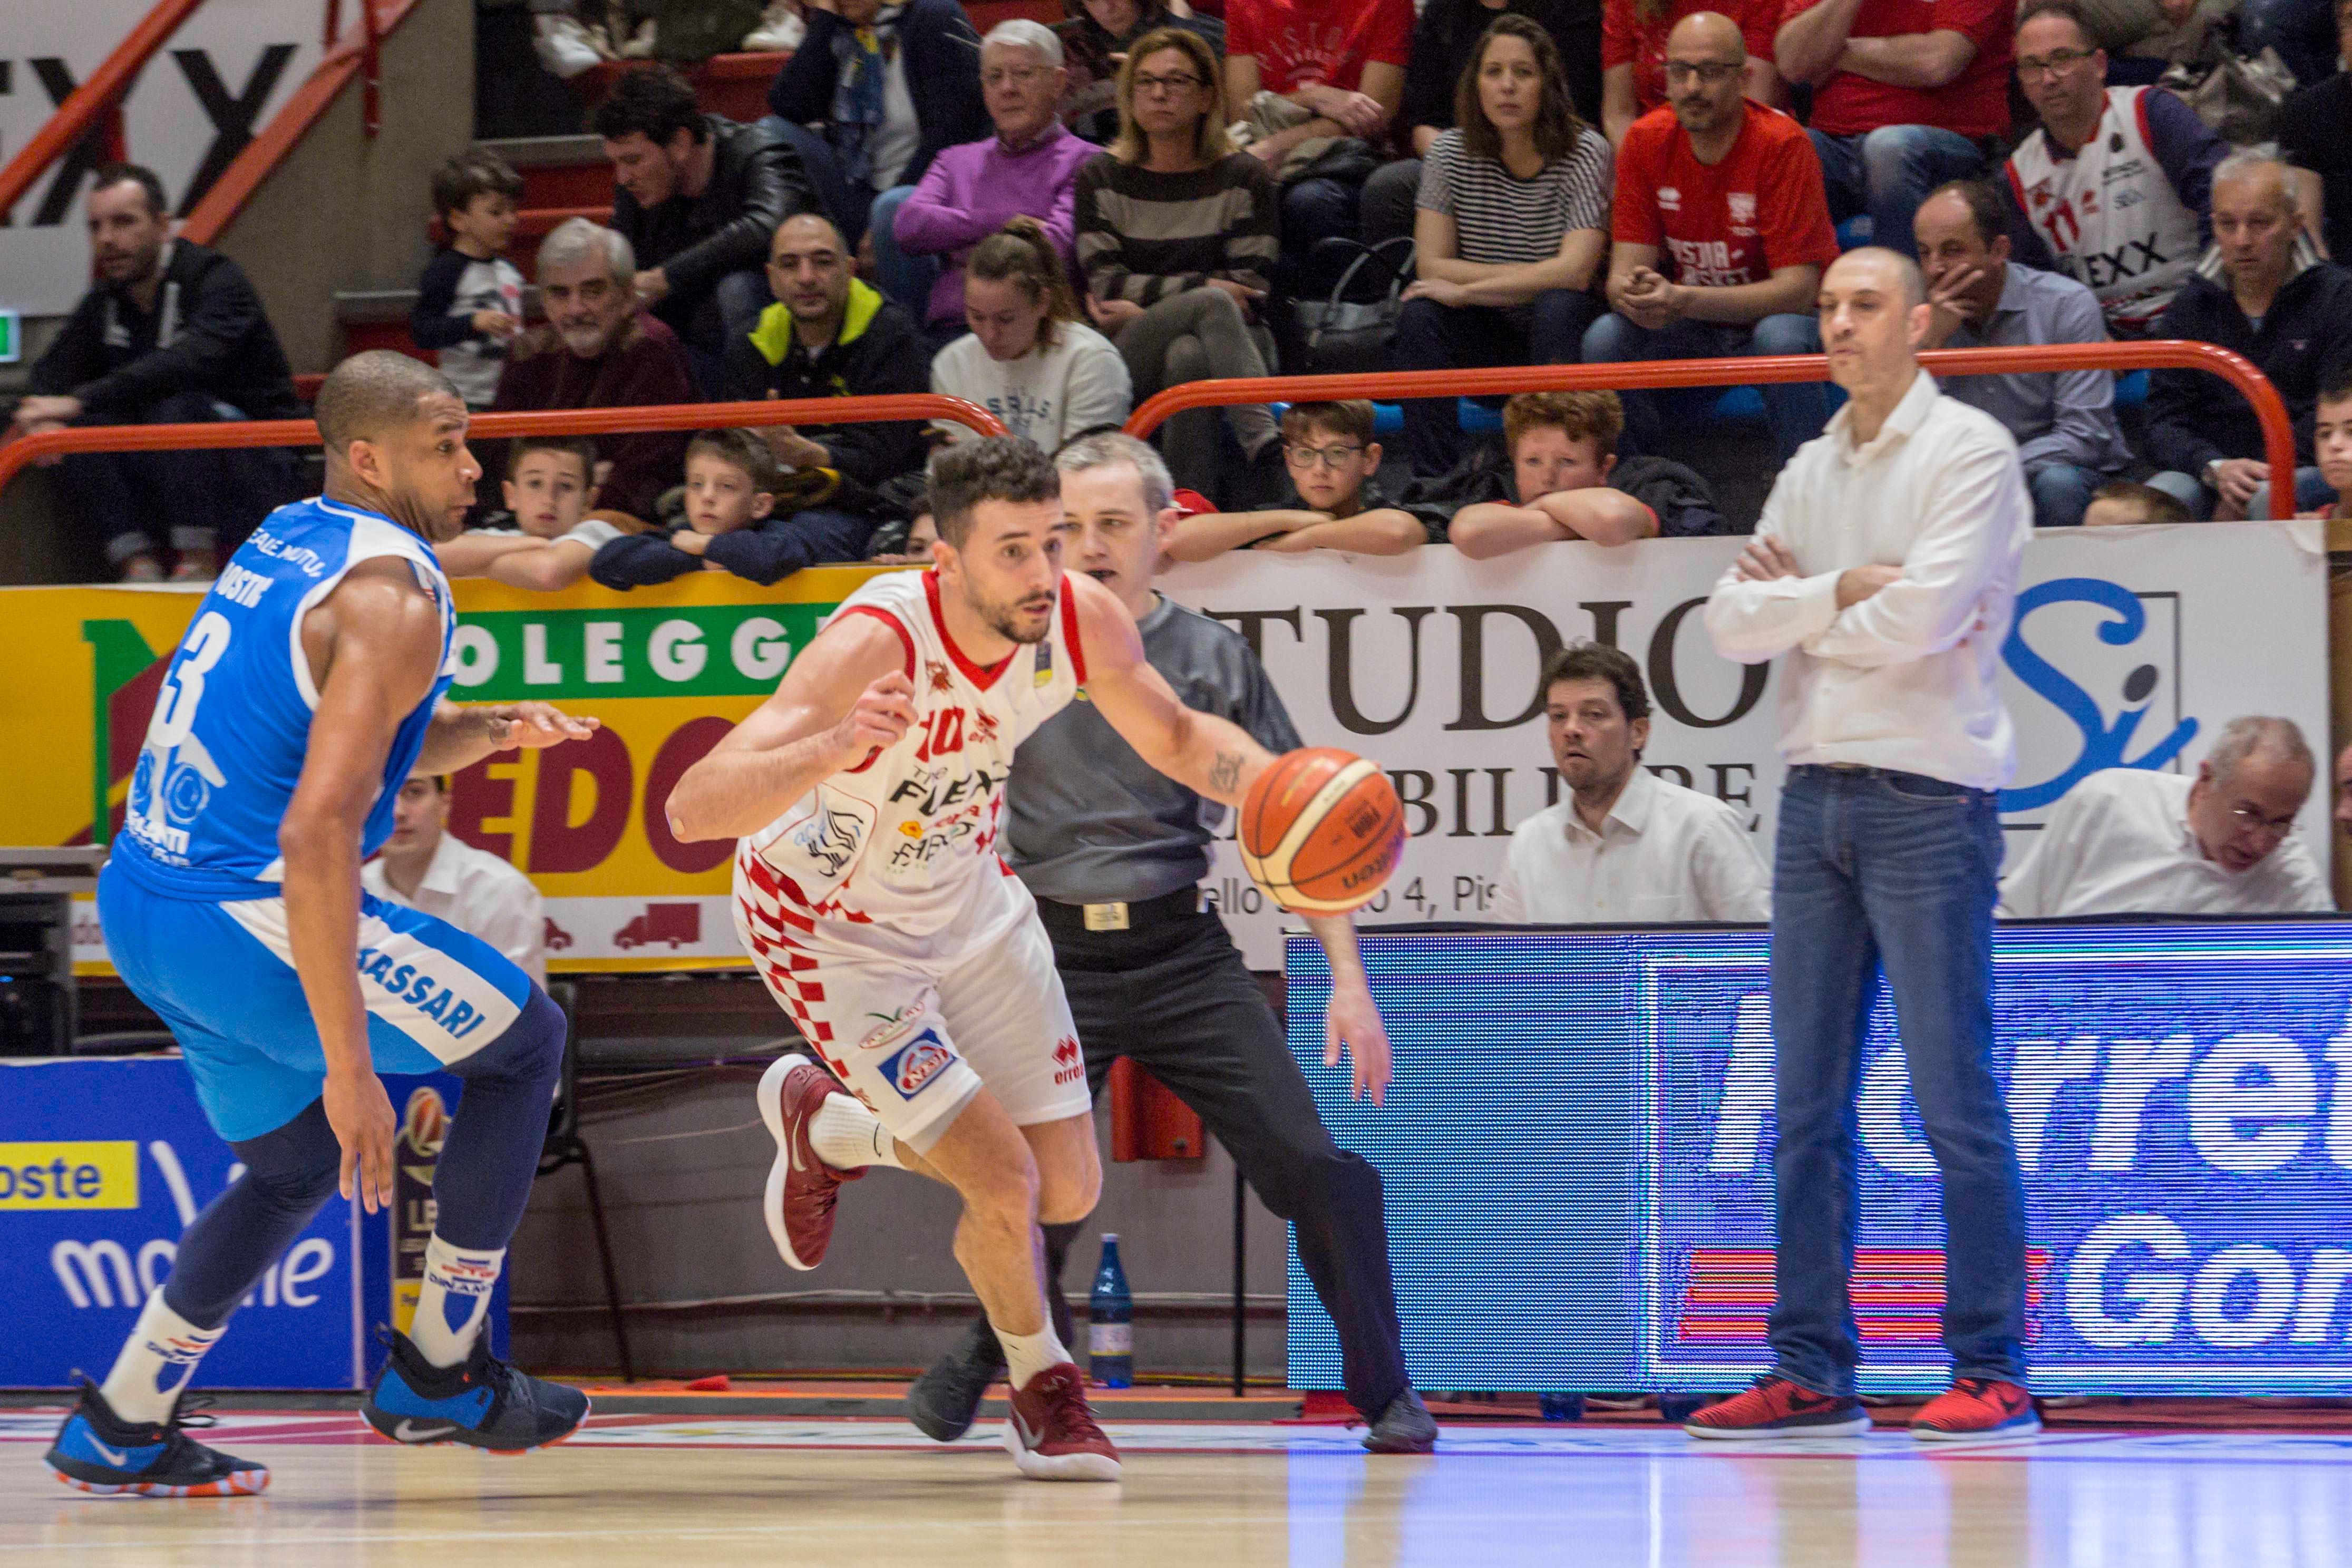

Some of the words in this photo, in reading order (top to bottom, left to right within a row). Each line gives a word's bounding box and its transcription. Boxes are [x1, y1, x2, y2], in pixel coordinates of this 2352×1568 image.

[0, 43, 299, 227] XX
[150, 611, 231, 747] 3
[454, 616, 829, 686] OLEGG
[914, 705, 966, 763] 10
[52, 1238, 335, 1308] moe
